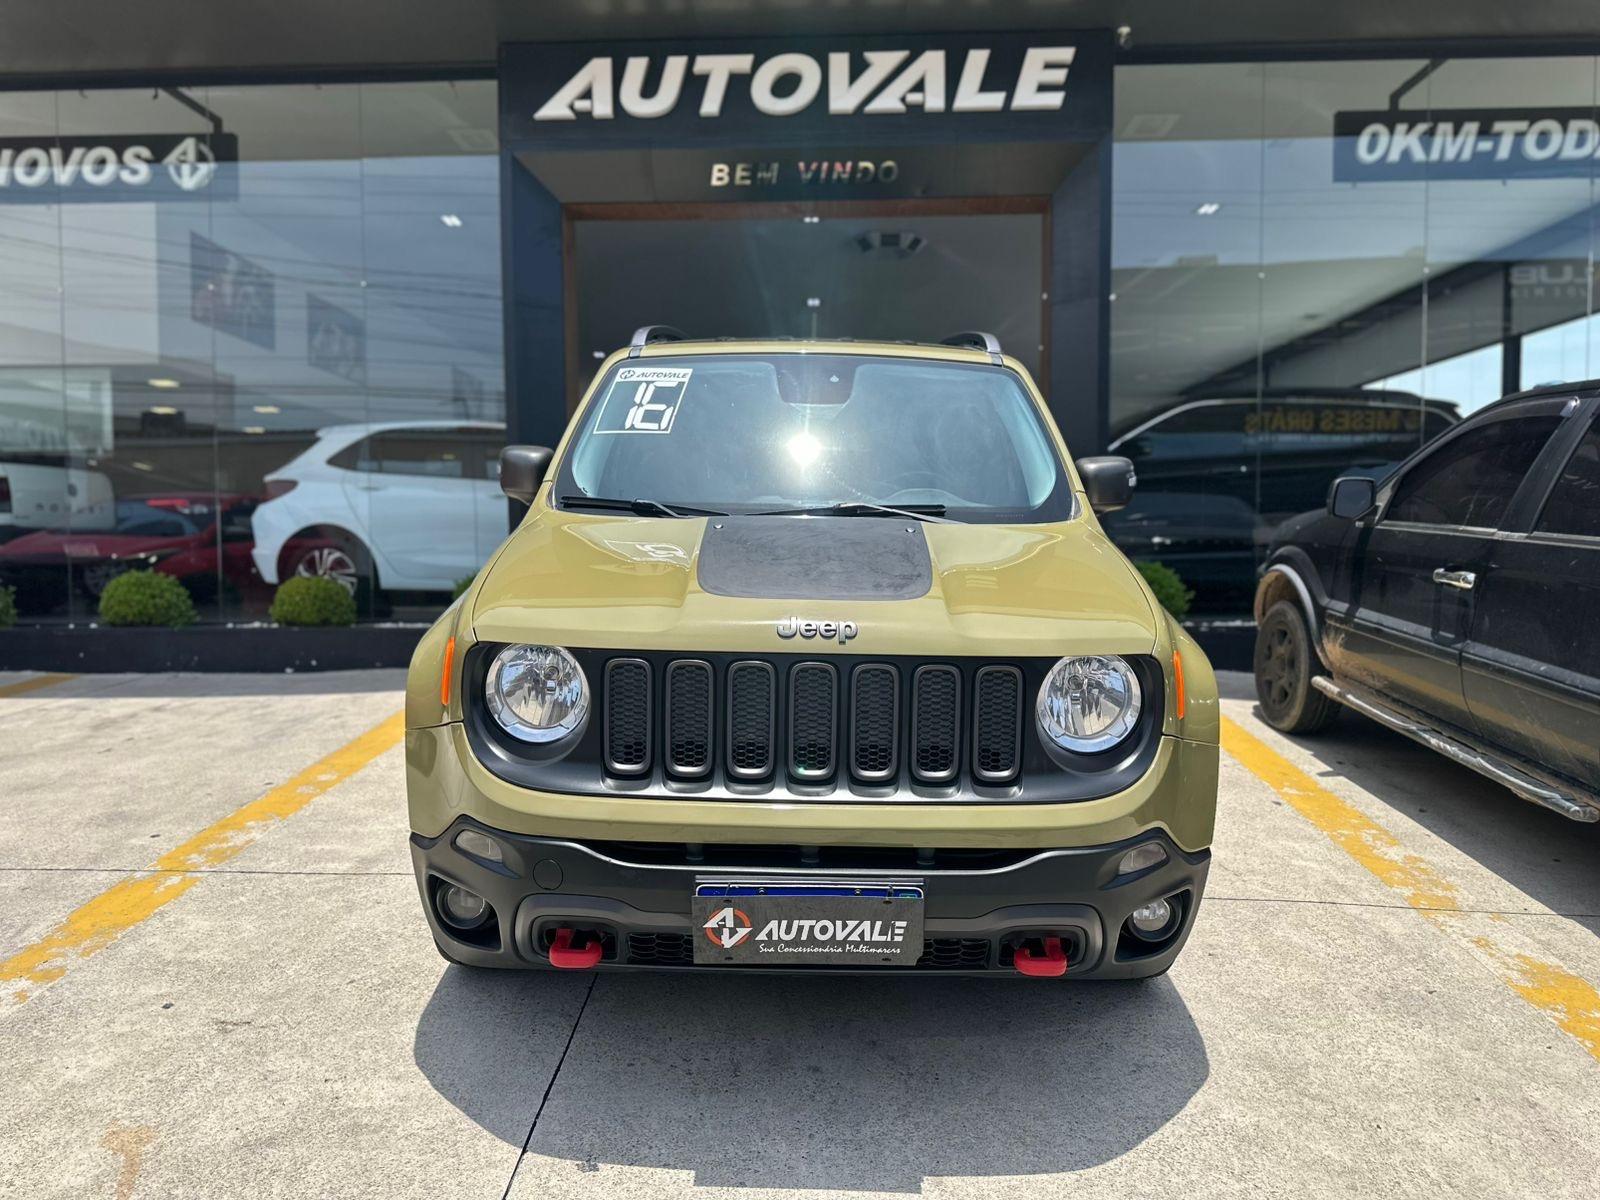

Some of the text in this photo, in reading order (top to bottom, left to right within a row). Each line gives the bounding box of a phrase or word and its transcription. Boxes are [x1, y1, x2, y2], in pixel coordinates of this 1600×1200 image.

[533, 46, 1076, 120] AUTOVALE
[710, 160, 899, 187] BEM VINDO
[625, 381, 679, 430] 16
[776, 616, 859, 645] Jeep
[755, 919, 907, 942] AUTOVALE
[759, 943, 775, 953] Sua
[777, 943, 843, 953] Concessionária
